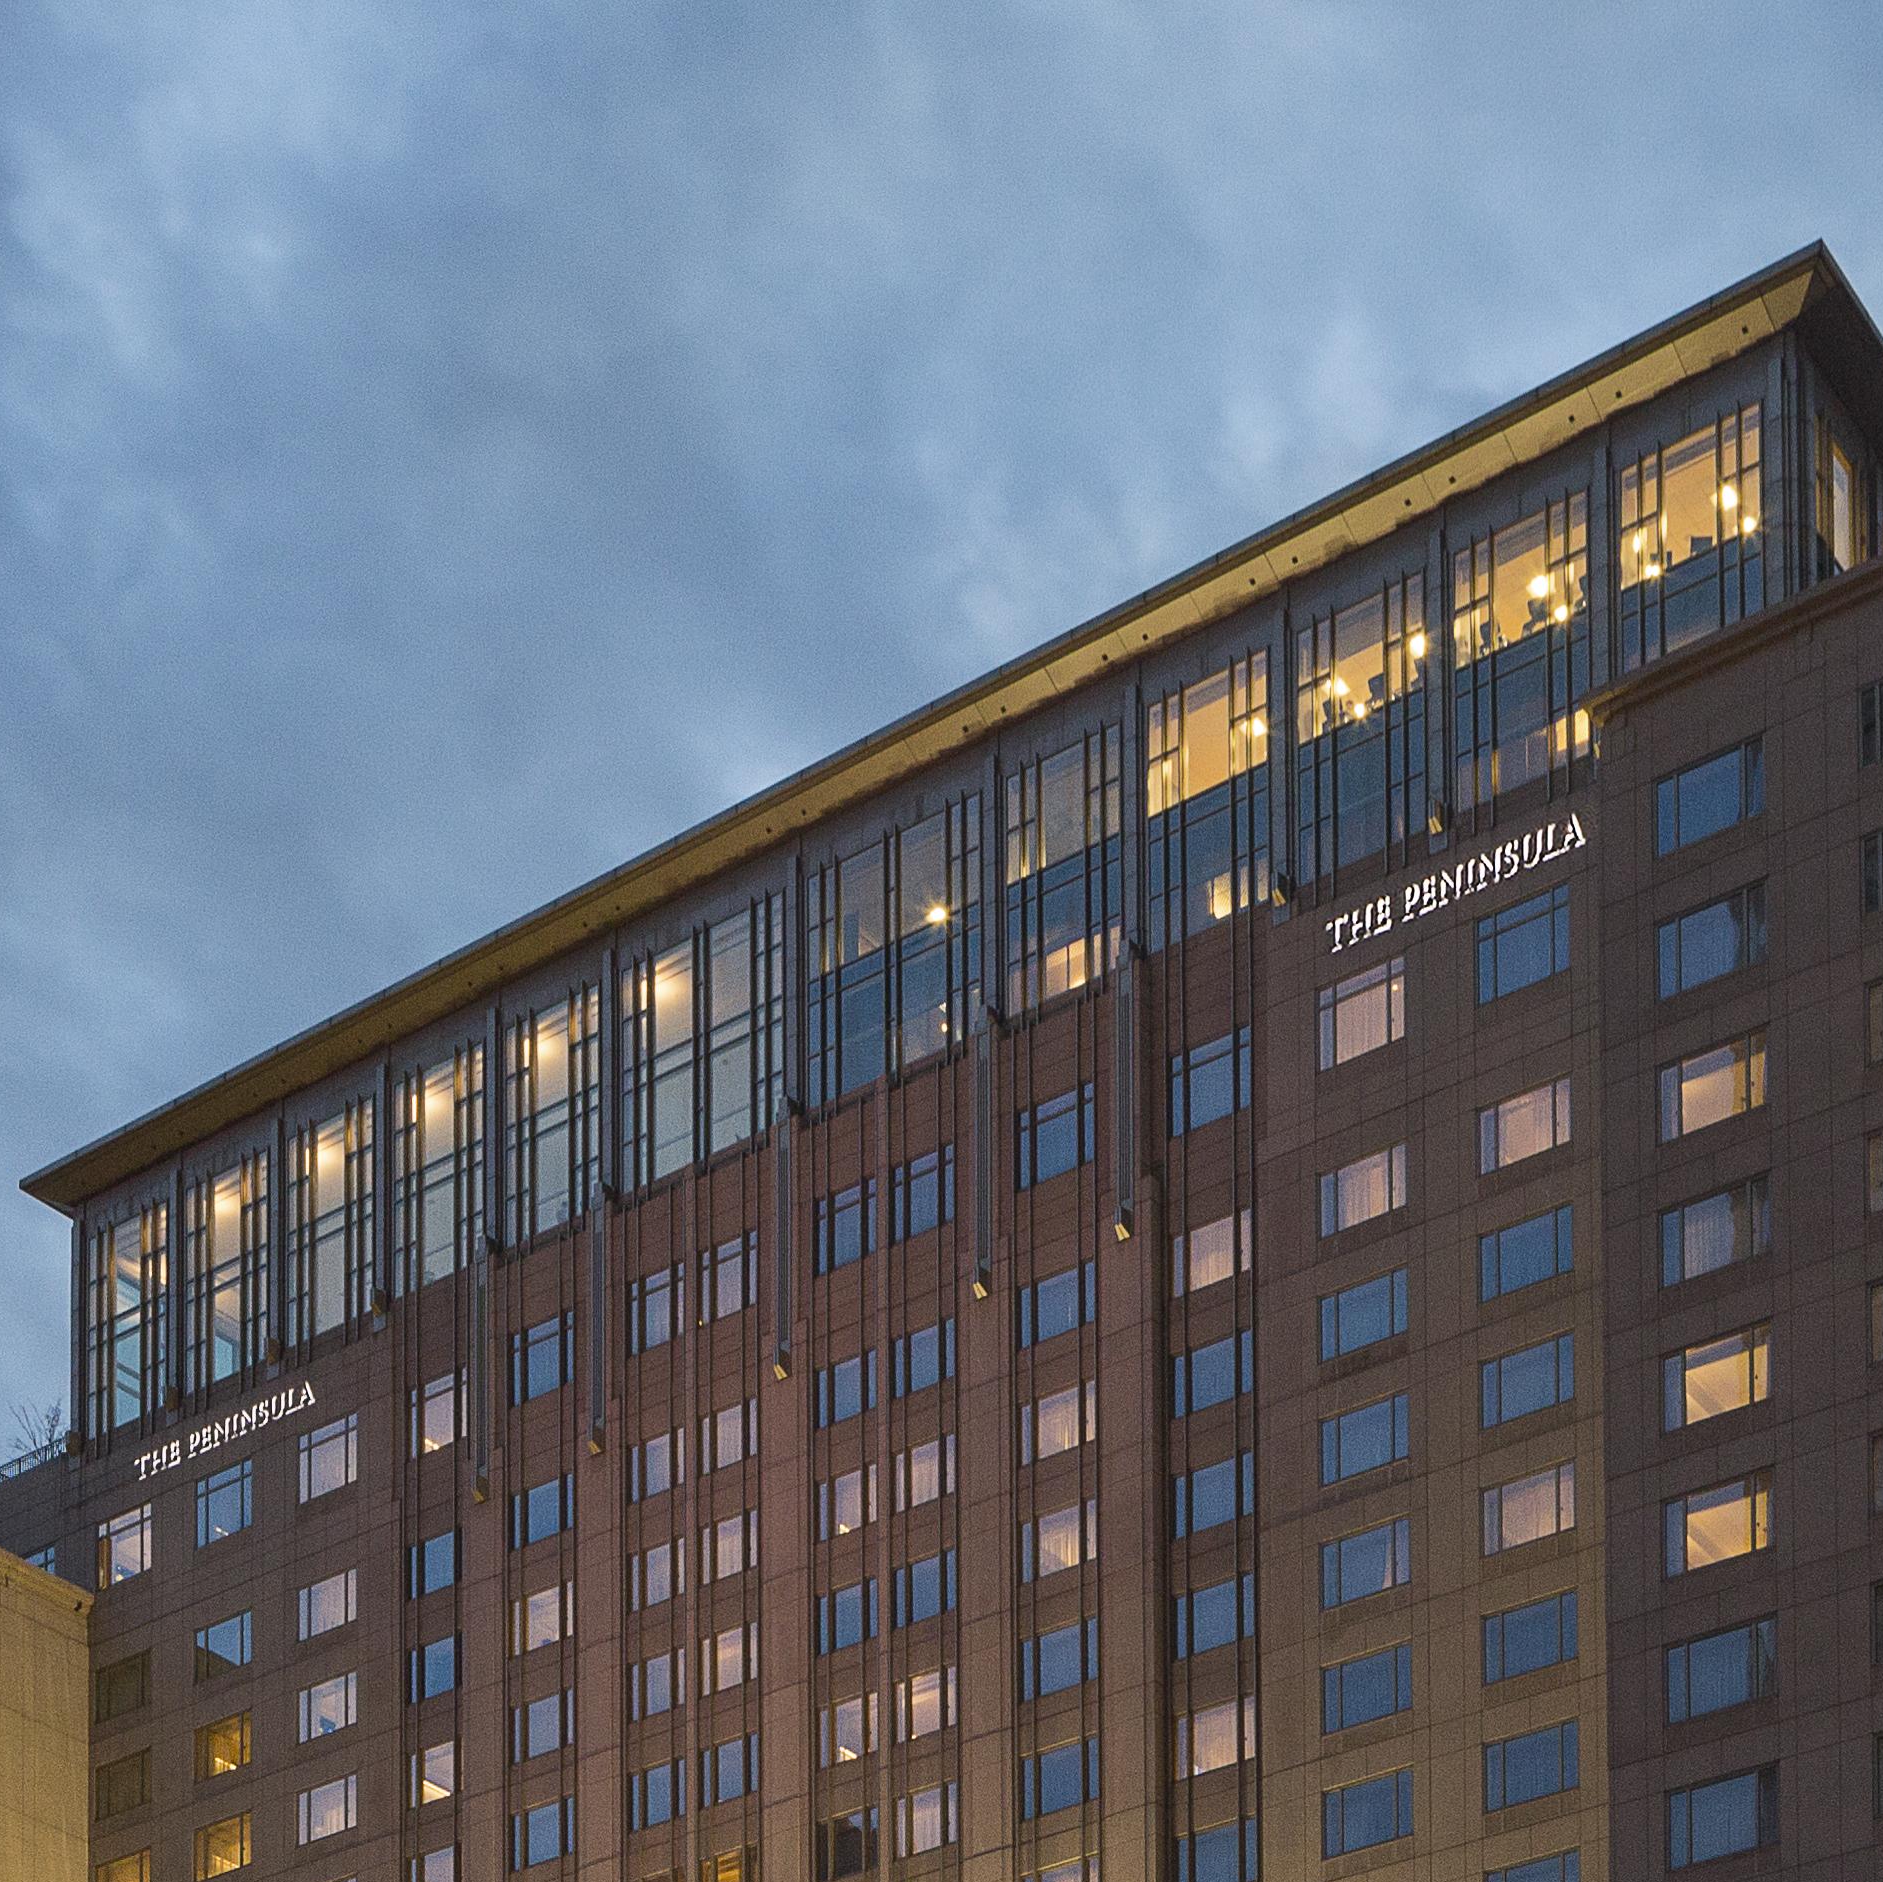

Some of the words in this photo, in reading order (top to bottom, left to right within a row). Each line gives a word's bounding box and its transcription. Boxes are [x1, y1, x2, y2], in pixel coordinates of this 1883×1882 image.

[1325, 894, 1392, 953] THE
[1401, 812, 1587, 922] PENINSULA
[133, 1439, 182, 1481] THE
[187, 1380, 316, 1460] PENINSULA
